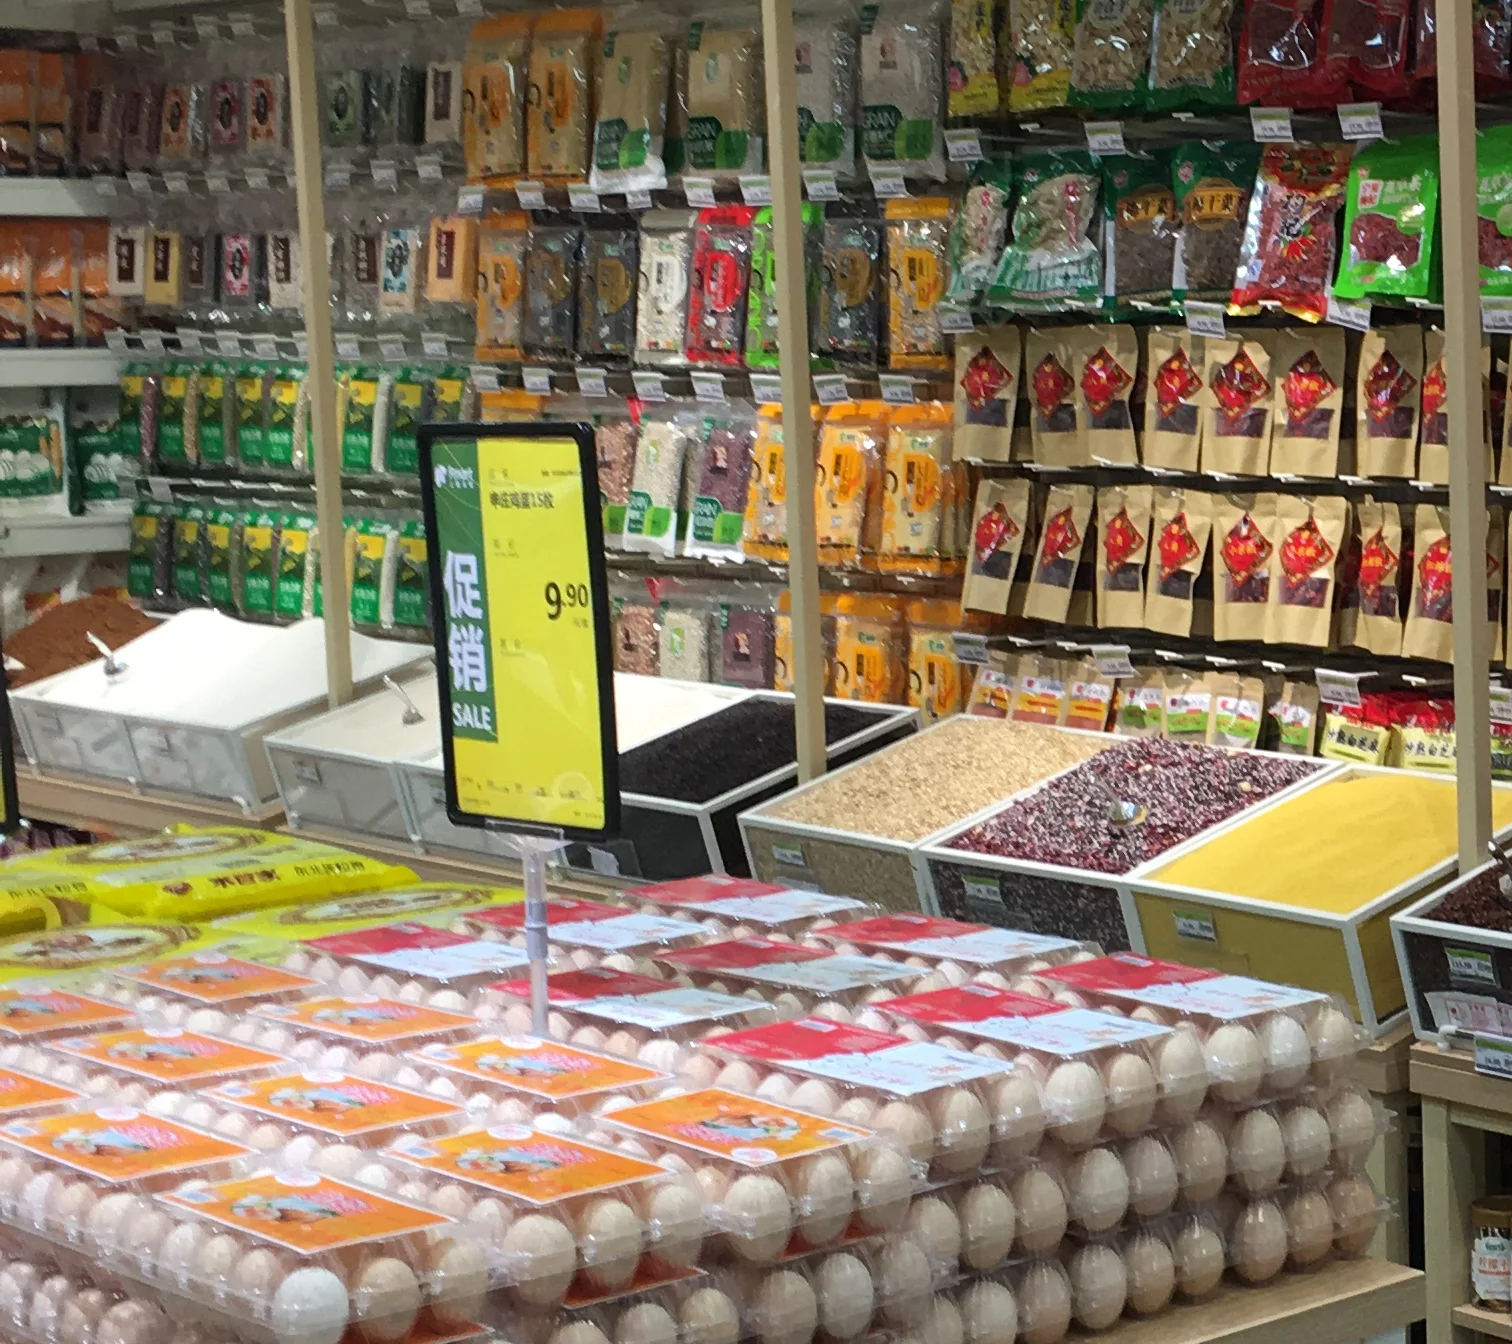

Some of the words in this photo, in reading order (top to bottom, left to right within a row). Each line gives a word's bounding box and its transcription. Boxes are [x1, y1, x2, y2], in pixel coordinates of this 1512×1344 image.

[443, 549, 488, 693] 促销
[544, 581, 589, 621] 9.90
[452, 701, 493, 732] SALE
